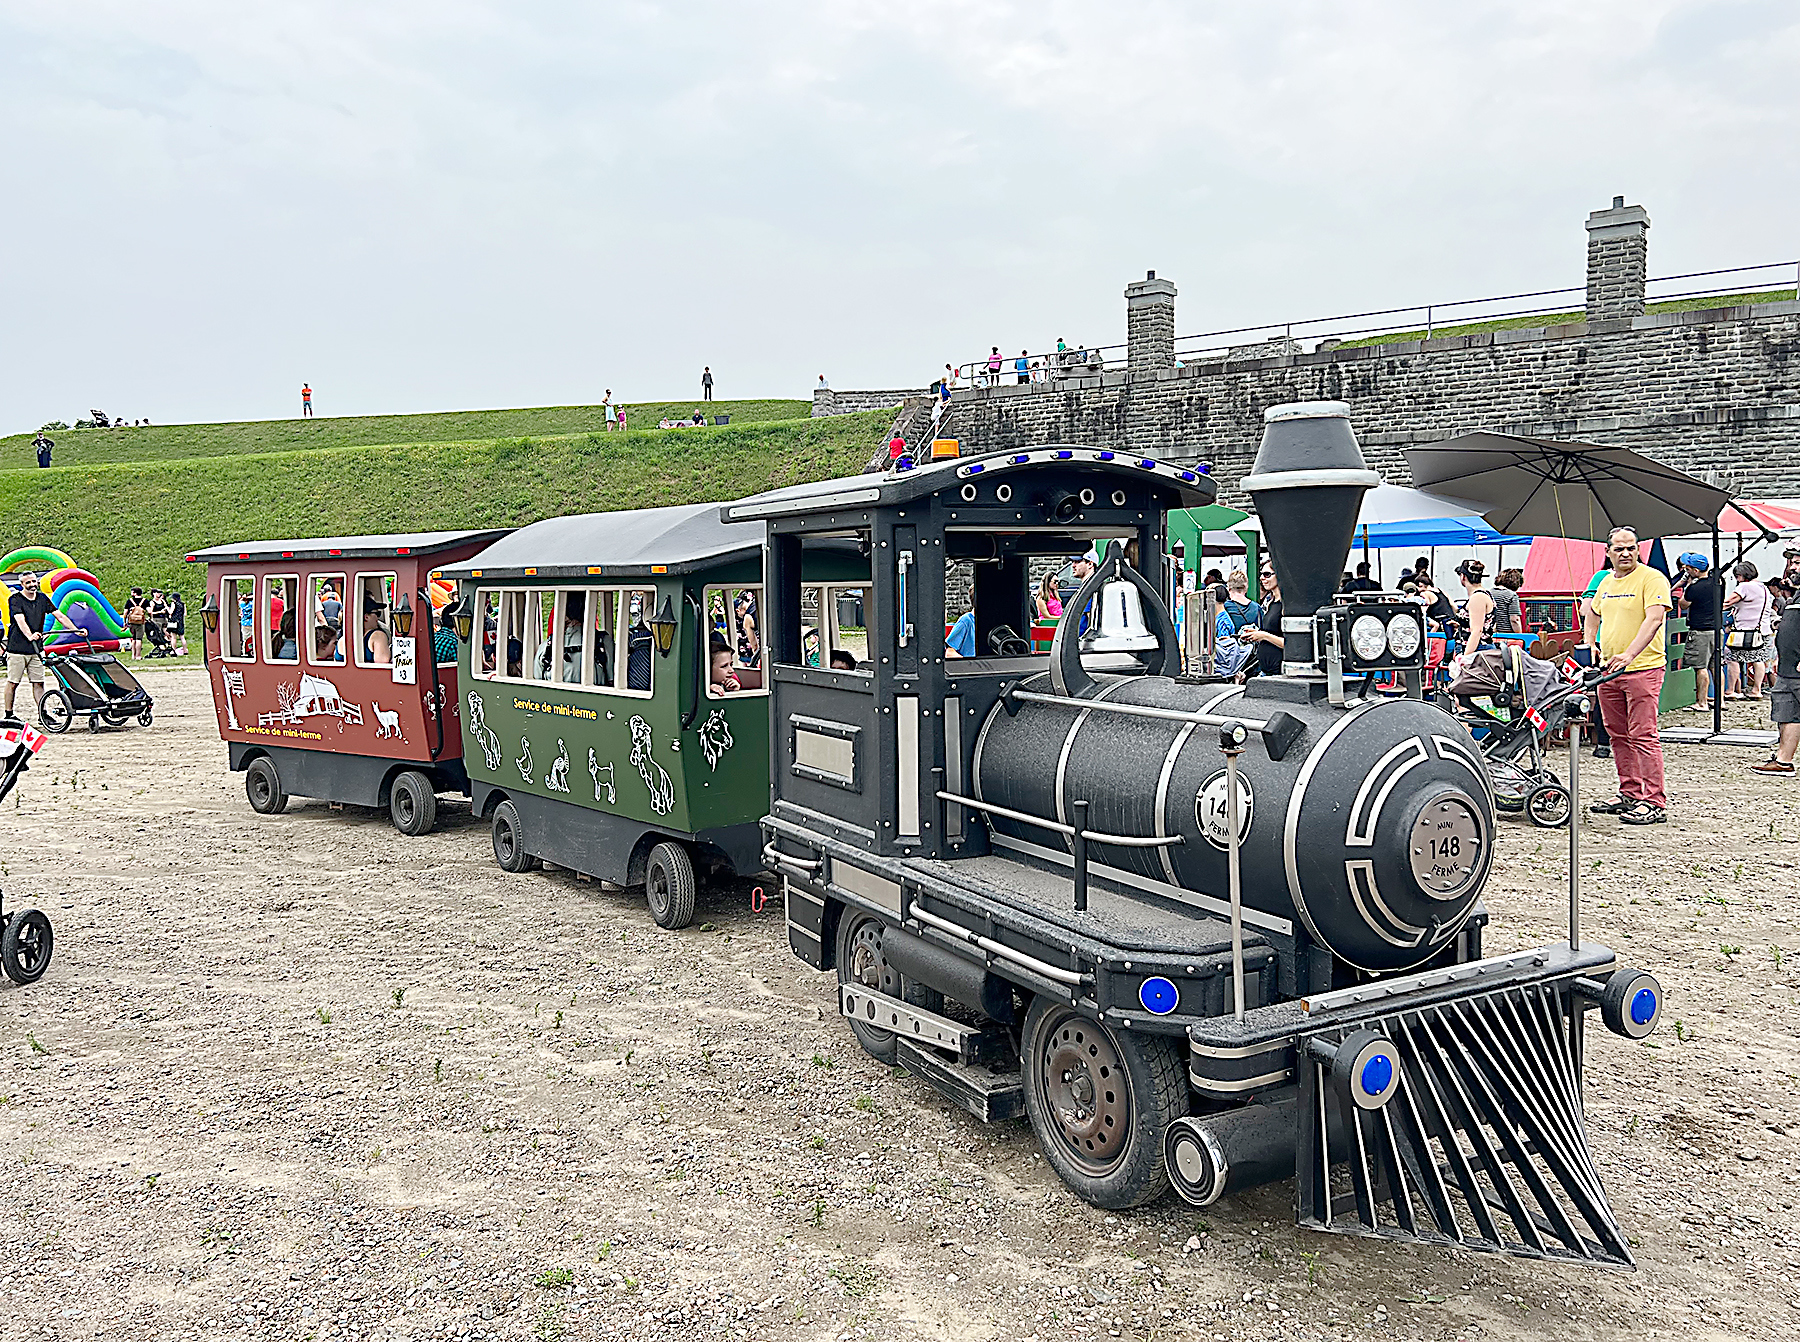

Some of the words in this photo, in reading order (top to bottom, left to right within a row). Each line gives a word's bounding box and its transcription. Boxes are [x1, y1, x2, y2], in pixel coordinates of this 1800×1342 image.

[396, 639, 411, 648] TOUR
[393, 653, 413, 669] Train
[513, 696, 541, 712] Service
[541, 701, 553, 714] de
[553, 703, 598, 721] mini-ferme
[244, 724, 271, 735] Service
[271, 727, 281, 736] de
[282, 728, 322, 741] mini-ferme
[1209, 796, 1229, 819] 14
[1208, 820, 1230, 837] FERM
[1437, 821, 1454, 831] MINI
[1429, 836, 1460, 860] 148
[1431, 861, 1460, 877] FERME
